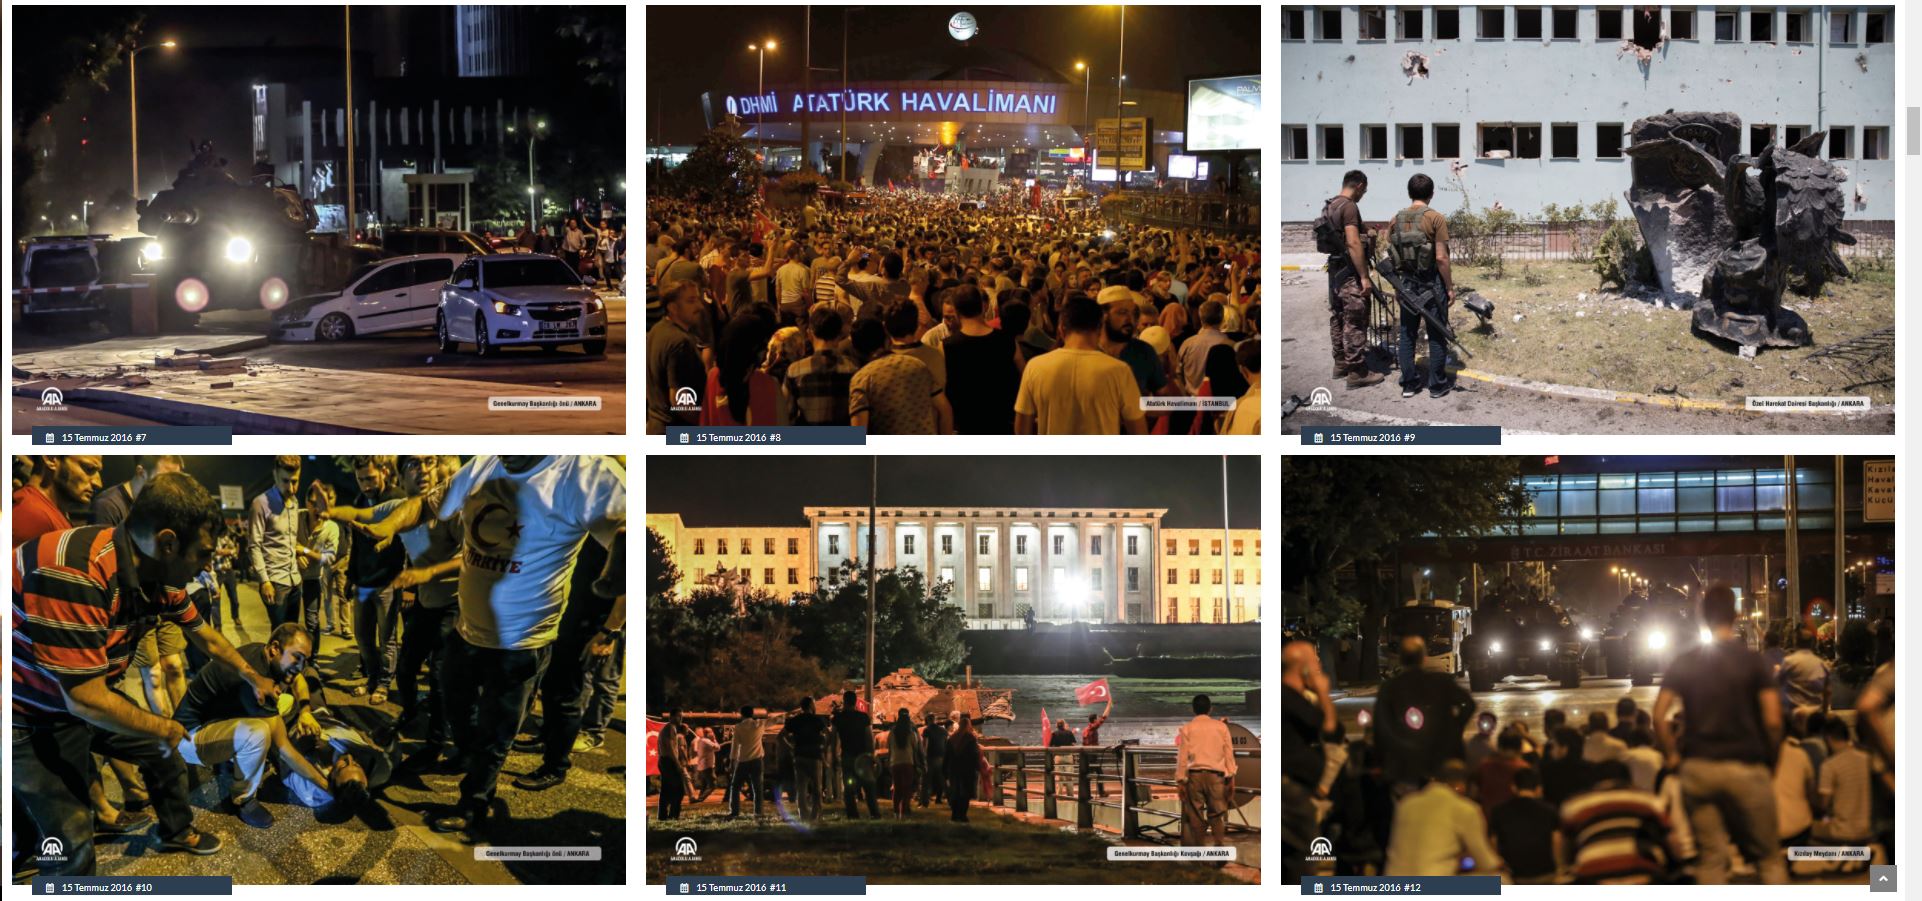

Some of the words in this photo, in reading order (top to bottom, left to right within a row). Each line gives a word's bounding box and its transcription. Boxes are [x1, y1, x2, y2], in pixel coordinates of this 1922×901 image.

[740, 91, 778, 114] DHMİ
[901, 89, 1055, 114] HAVALİMANI
[1550, 545, 1600, 557] ZİRAAT
[1603, 544, 1665, 555] BANKASI
